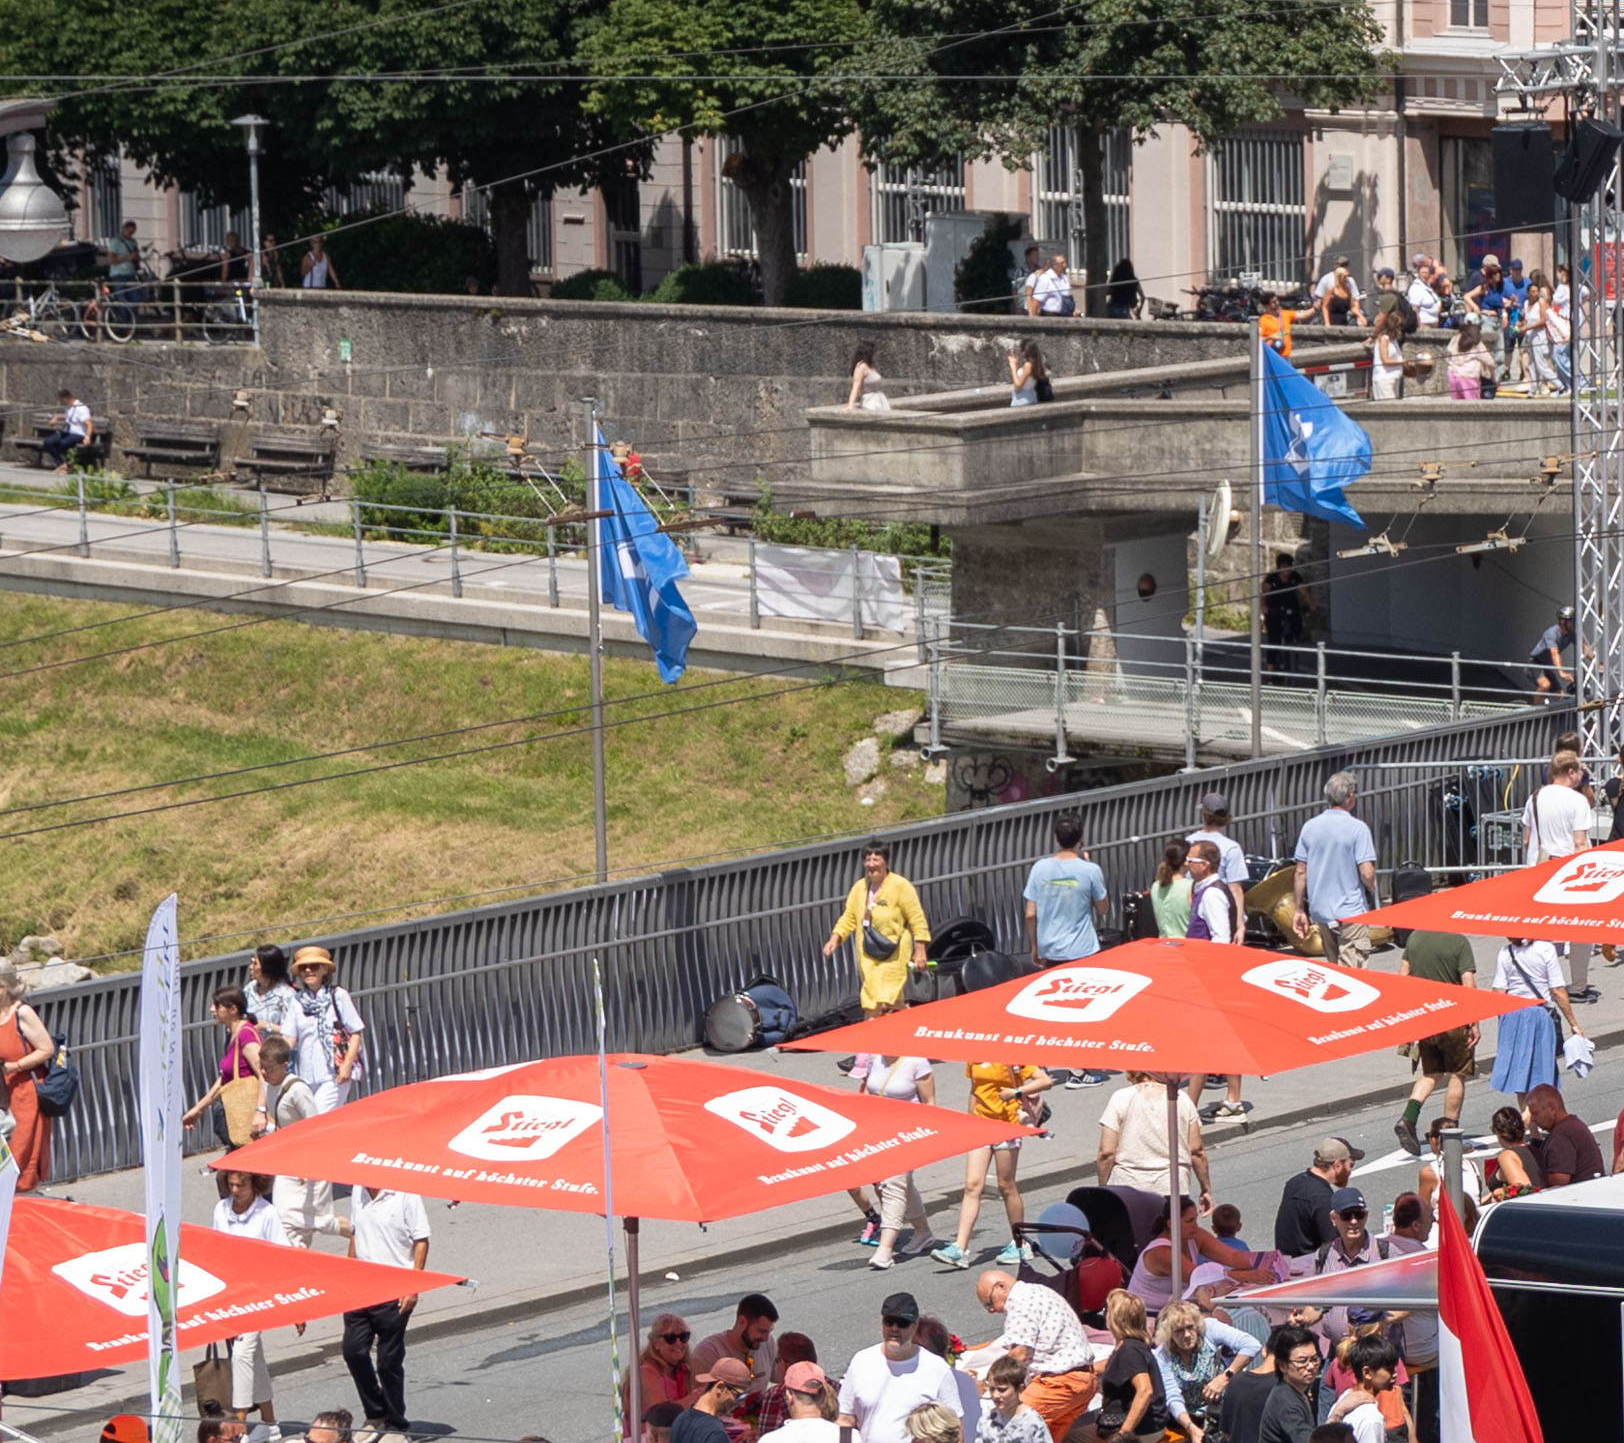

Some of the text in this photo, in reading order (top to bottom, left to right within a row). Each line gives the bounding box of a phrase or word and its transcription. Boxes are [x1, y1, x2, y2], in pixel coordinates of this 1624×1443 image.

[1033, 975, 1124, 999] Stiegl
[913, 1025, 1156, 1055] Braukunst auf höchster Stufe.
[480, 1110, 578, 1136] Stiegl
